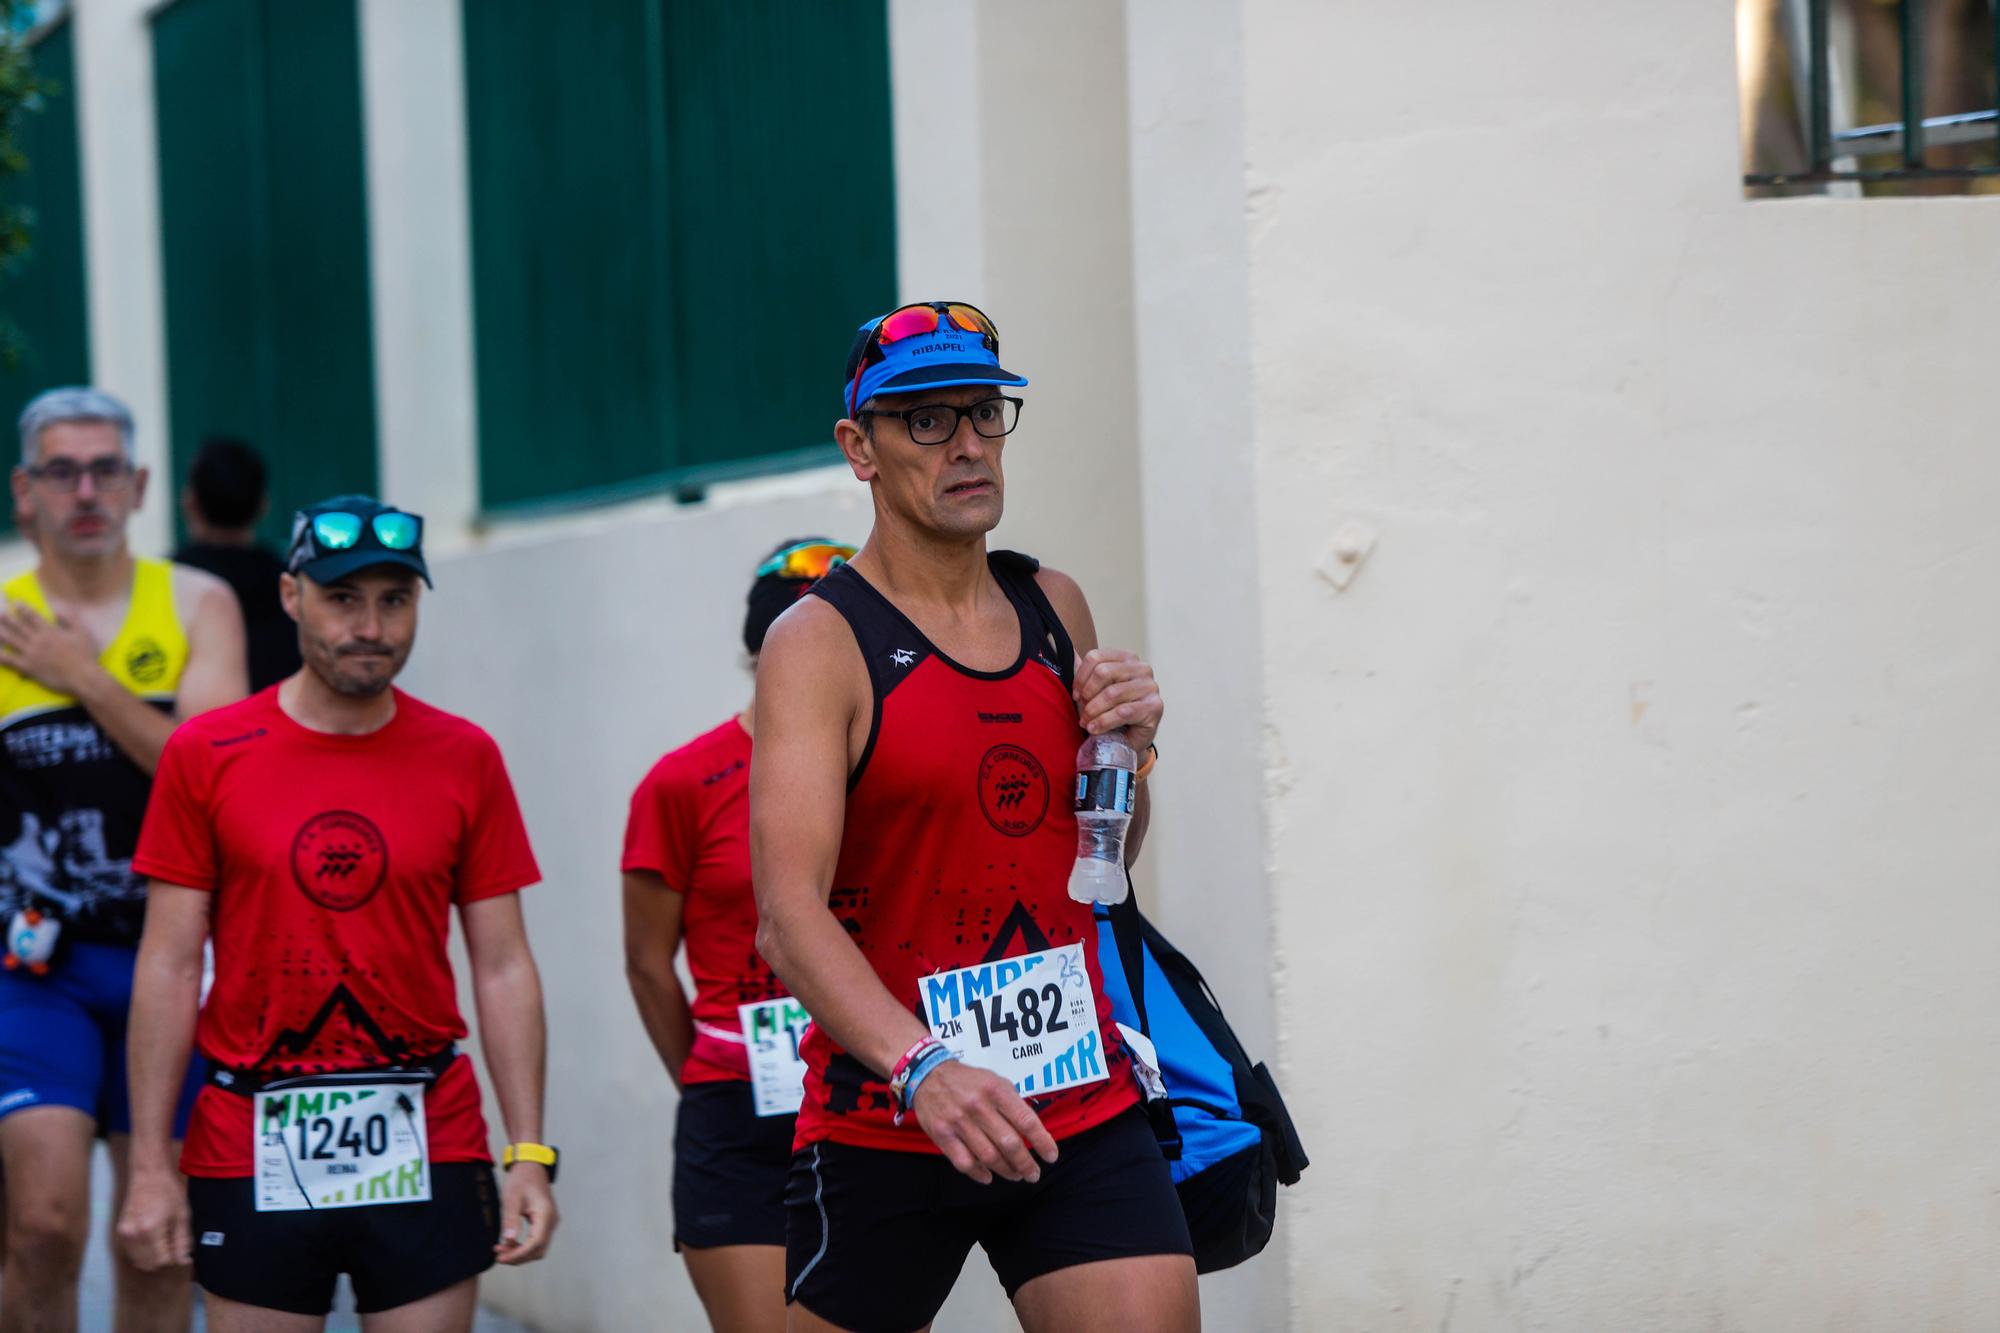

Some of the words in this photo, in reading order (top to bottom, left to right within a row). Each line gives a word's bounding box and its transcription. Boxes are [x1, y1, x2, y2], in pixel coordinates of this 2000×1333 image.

[912, 343, 964, 356] RIBAPEU
[928, 955, 1044, 1026] MM
[939, 1019, 963, 1039] 21k
[966, 982, 1069, 1048] 1482
[1012, 1042, 1043, 1059] CARRI
[294, 1113, 387, 1160] 1240
